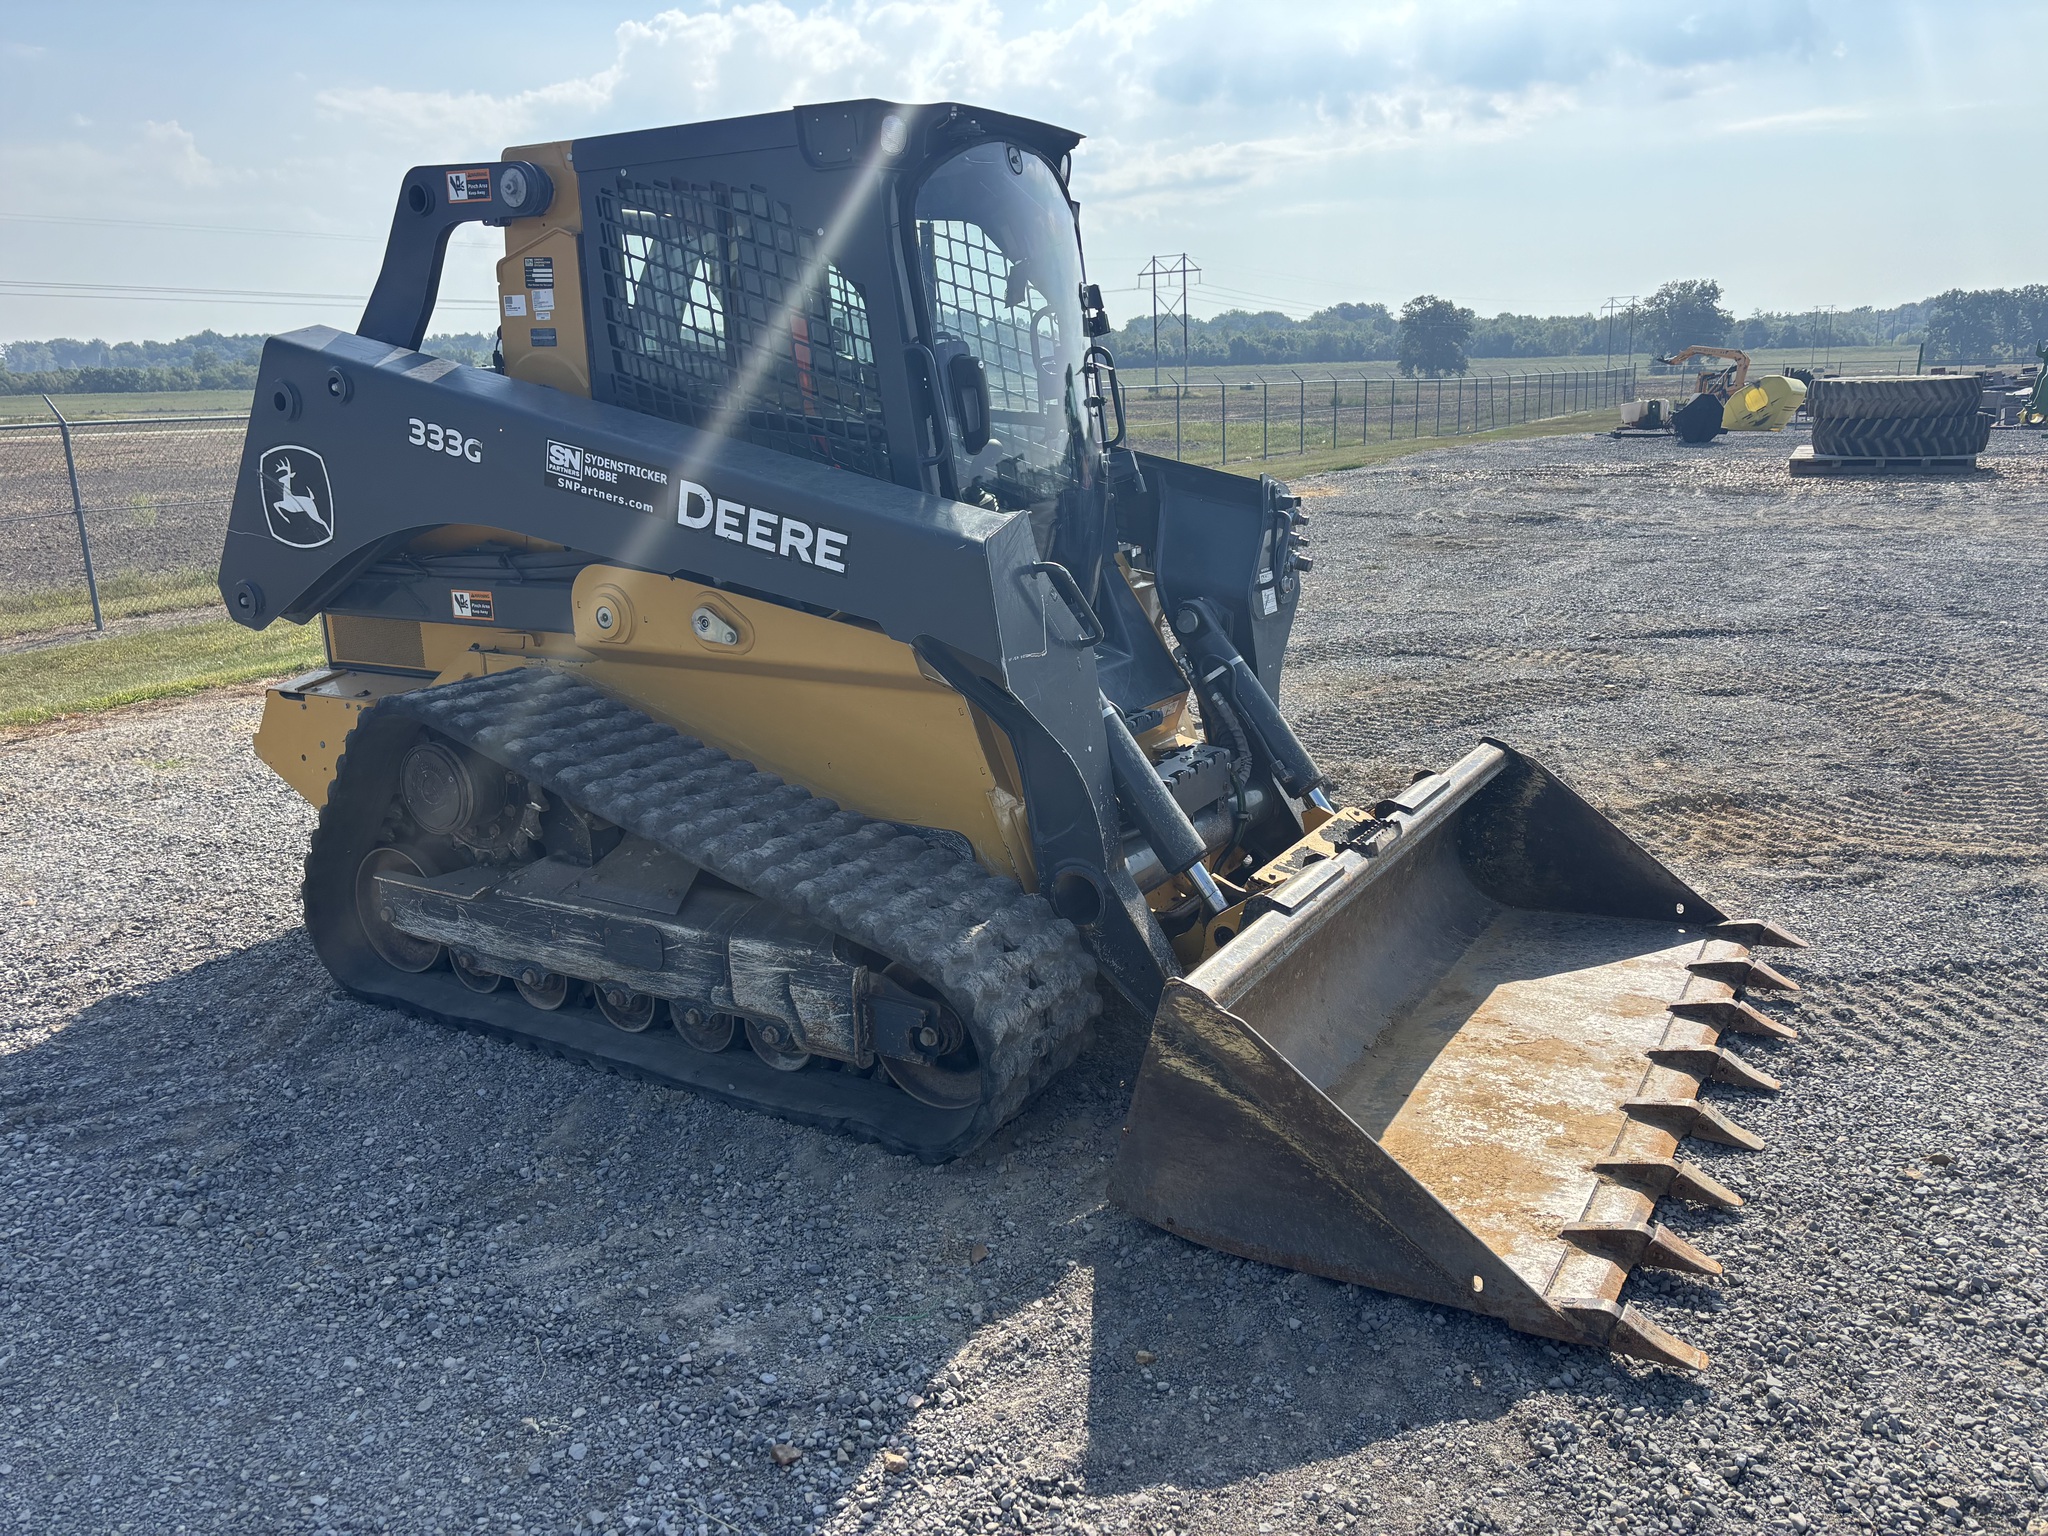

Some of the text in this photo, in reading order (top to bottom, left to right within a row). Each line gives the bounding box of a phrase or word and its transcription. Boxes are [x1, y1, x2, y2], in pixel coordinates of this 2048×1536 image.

[408, 418, 482, 463] 333G
[548, 463, 580, 477] PARTNERS
[549, 444, 581, 471] SN
[584, 453, 668, 485] SYDENSTRICKER
[584, 465, 618, 484] NOBBE
[557, 478, 654, 513] SNPartners.com
[677, 479, 848, 573] DEERE
